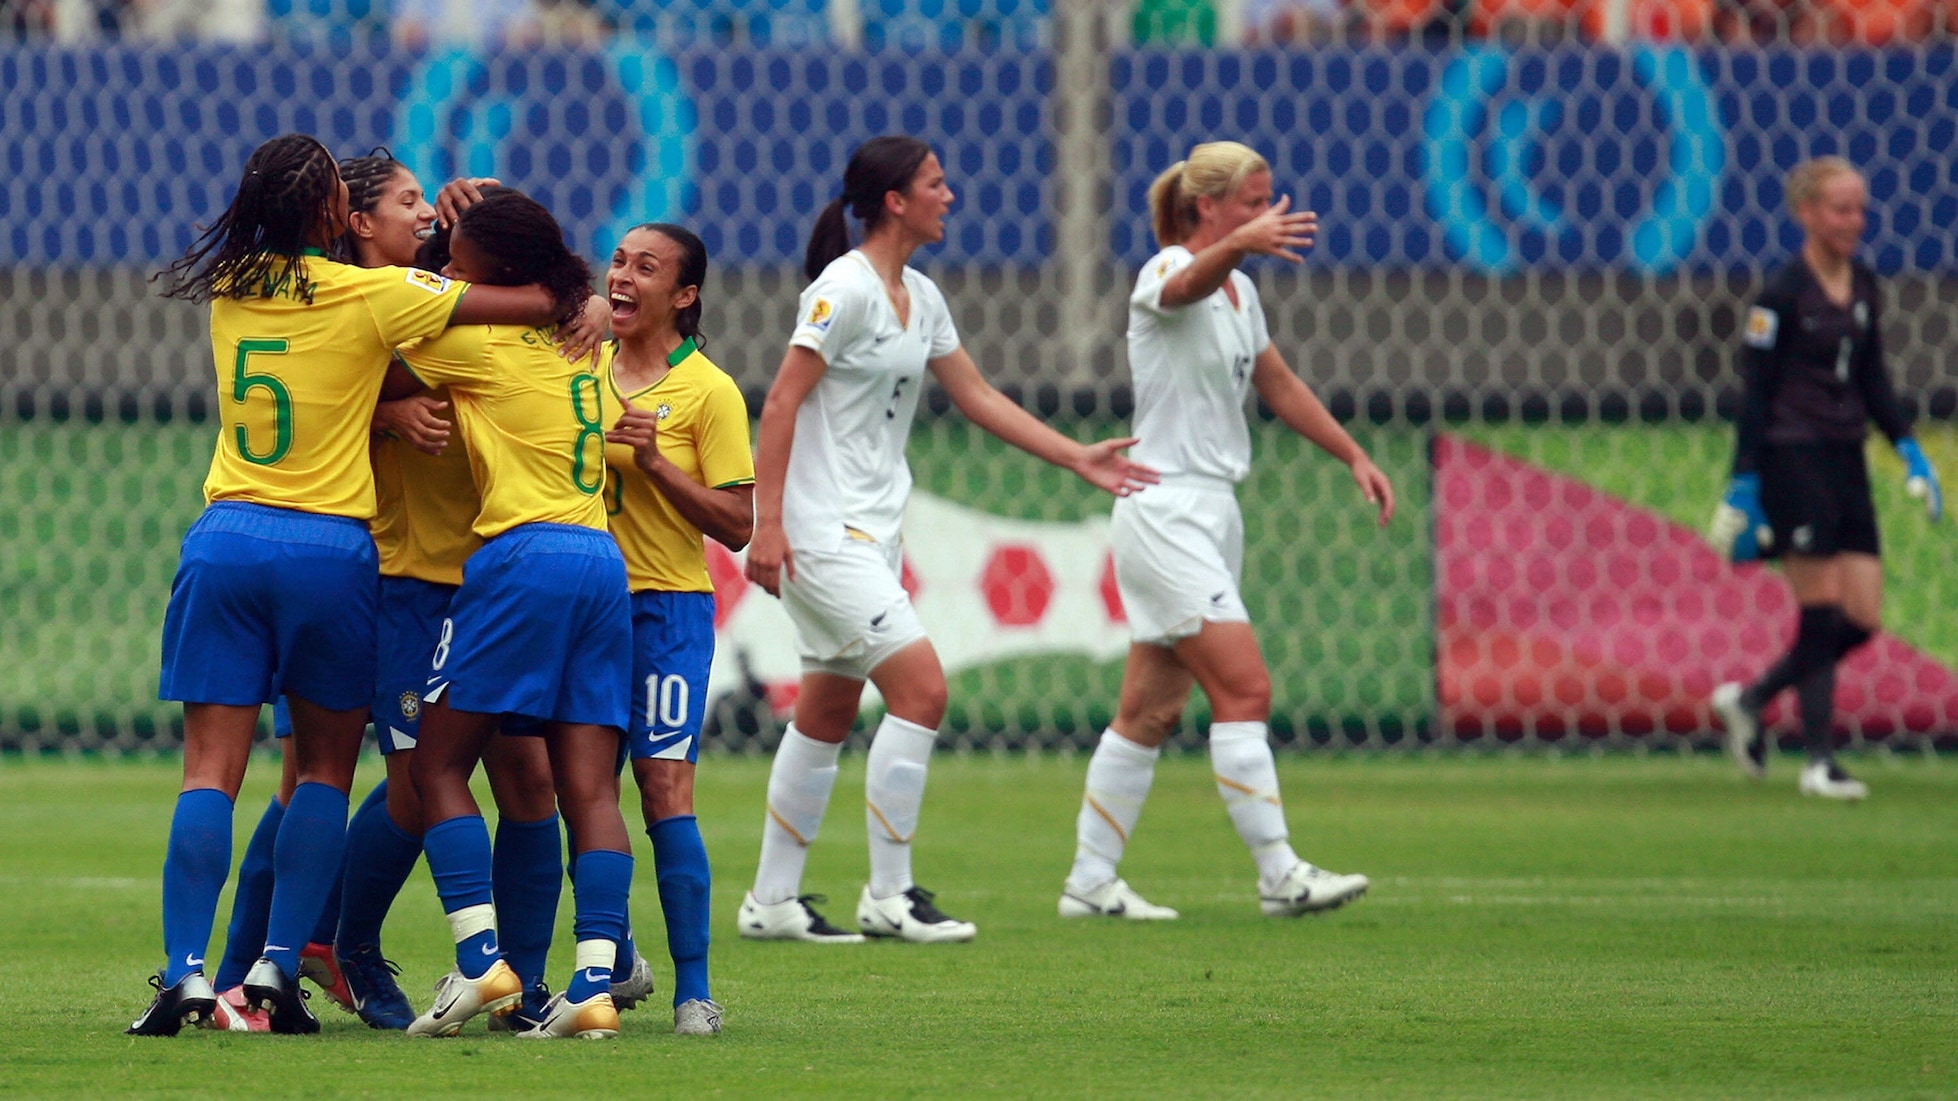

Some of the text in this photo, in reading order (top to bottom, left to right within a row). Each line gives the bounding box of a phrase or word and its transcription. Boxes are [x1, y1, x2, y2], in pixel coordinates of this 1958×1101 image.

[233, 268, 318, 303] ENAA
[232, 337, 294, 466] 5
[886, 376, 909, 419] 5
[569, 371, 604, 496] 8
[432, 618, 453, 671] 8
[645, 673, 689, 728] 10
